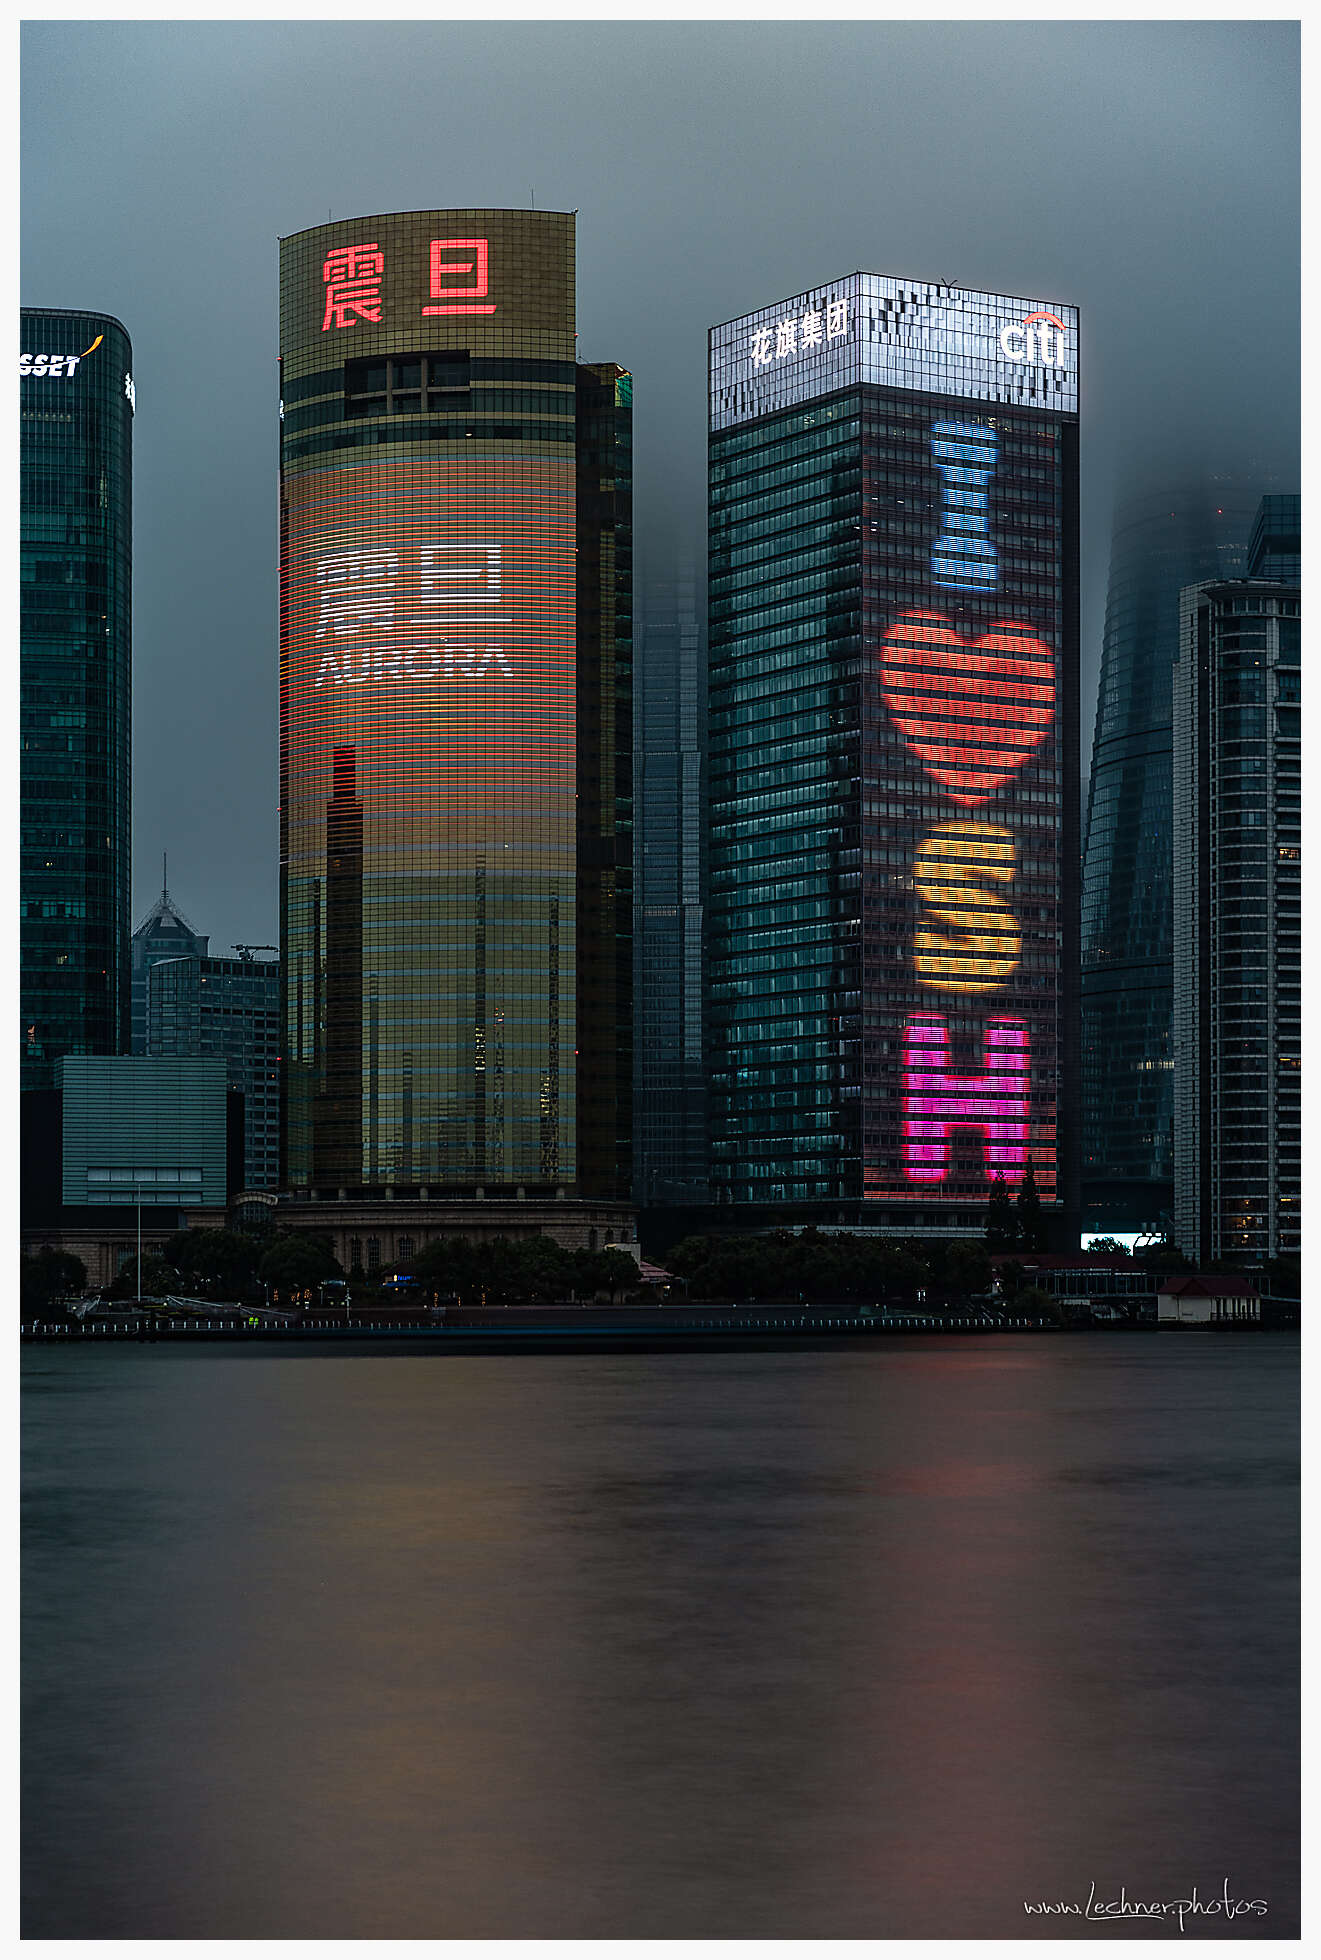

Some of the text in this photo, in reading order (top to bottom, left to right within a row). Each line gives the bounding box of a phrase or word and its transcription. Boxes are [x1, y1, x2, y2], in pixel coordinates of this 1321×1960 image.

[322, 237, 498, 332] 震旦
[750, 298, 849, 369] 花旗集团
[999, 314, 1066, 367] citi
[314, 544, 513, 639] 震旦
[314, 643, 514, 687] AURORA
